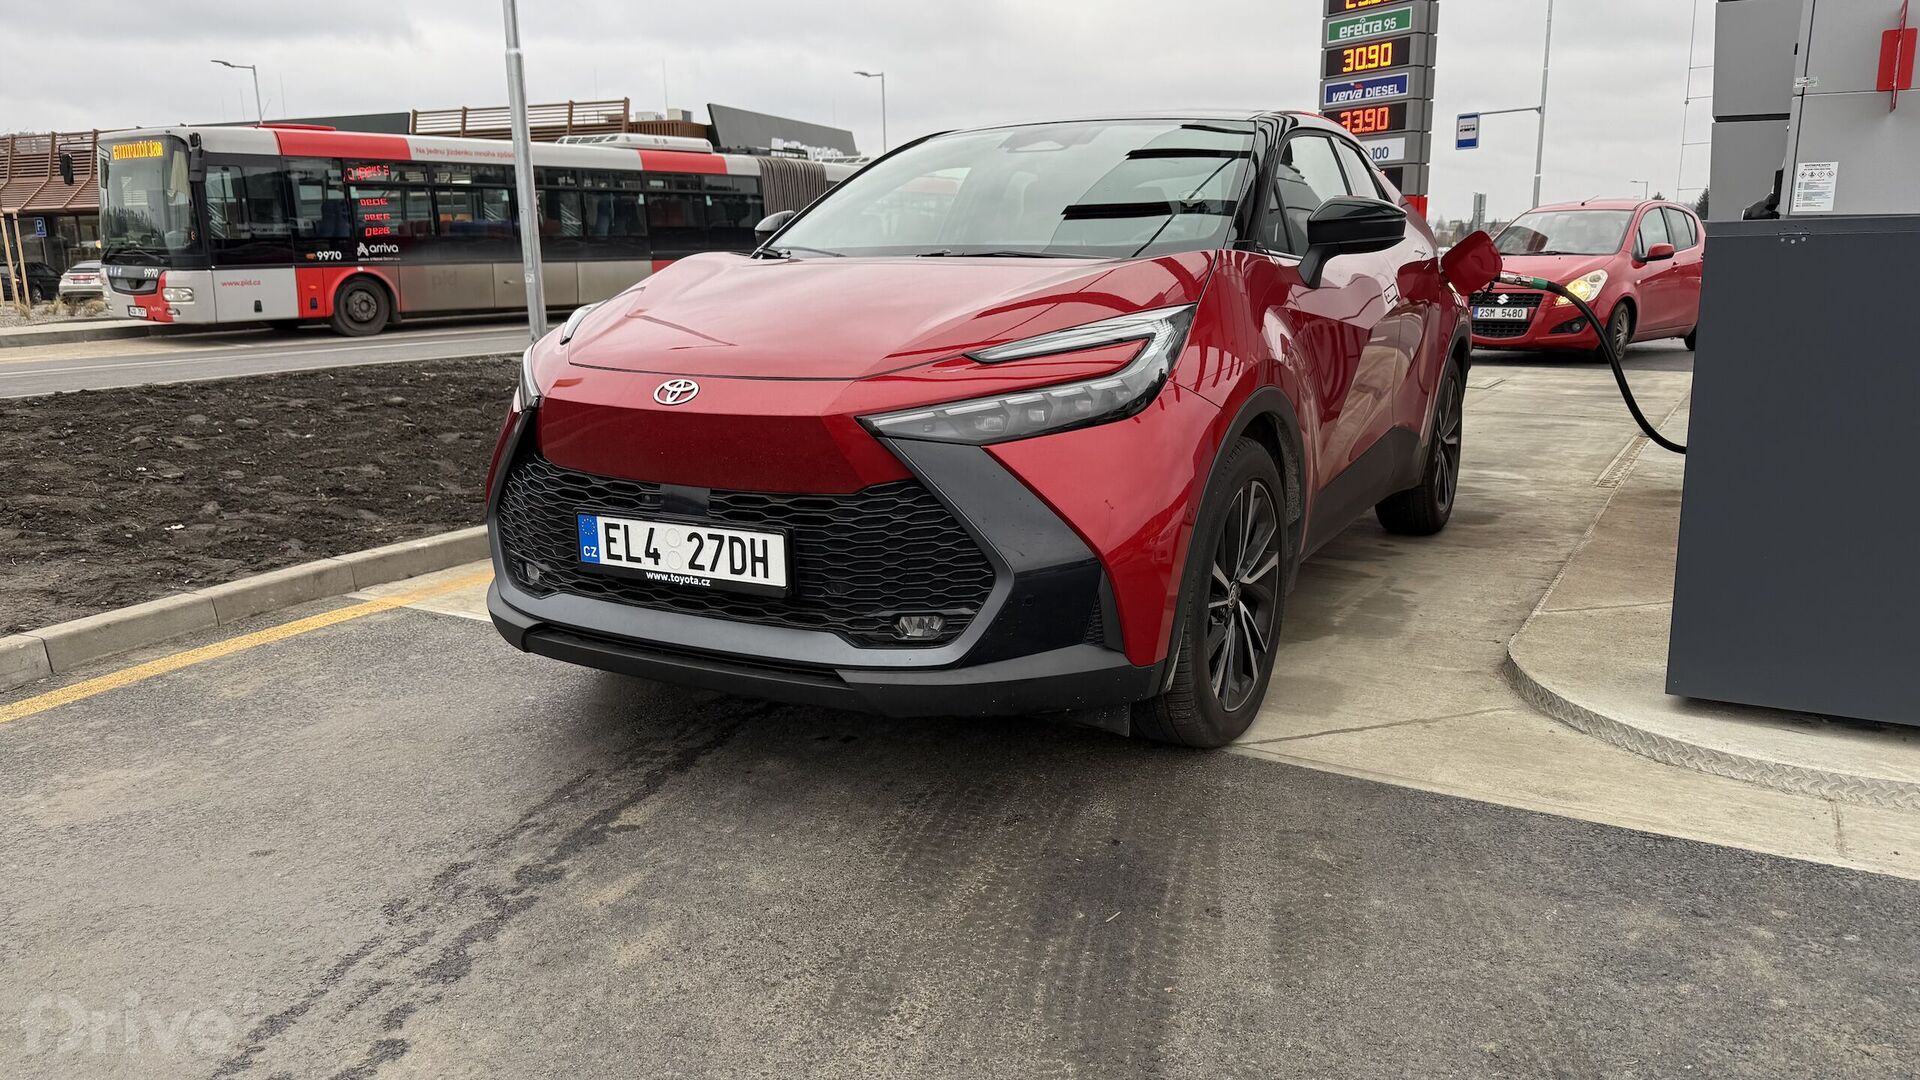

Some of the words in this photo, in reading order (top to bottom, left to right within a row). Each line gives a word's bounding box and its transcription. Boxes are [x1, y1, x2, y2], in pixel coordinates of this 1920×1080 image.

[1383, 18, 1397, 30] 95
[1343, 42, 1392, 72] 30.90
[1332, 89, 1363, 102] verva
[1365, 84, 1399, 97] DIESEL
[1340, 107, 1389, 133] 33.90
[1371, 146, 1389, 159] 100
[36, 219, 43, 231] P
[369, 243, 399, 253] arriva
[317, 251, 342, 261] 9970
[144, 268, 159, 278] 9970
[221, 279, 261, 288] www.pid.cz
[1480, 308, 1496, 318] 2SM
[1501, 308, 1523, 318] 5480
[583, 545, 598, 558] CZ
[604, 522, 661, 566] EL4
[687, 532, 769, 579] 27DH
[646, 571, 711, 587] www.toyota.cz
